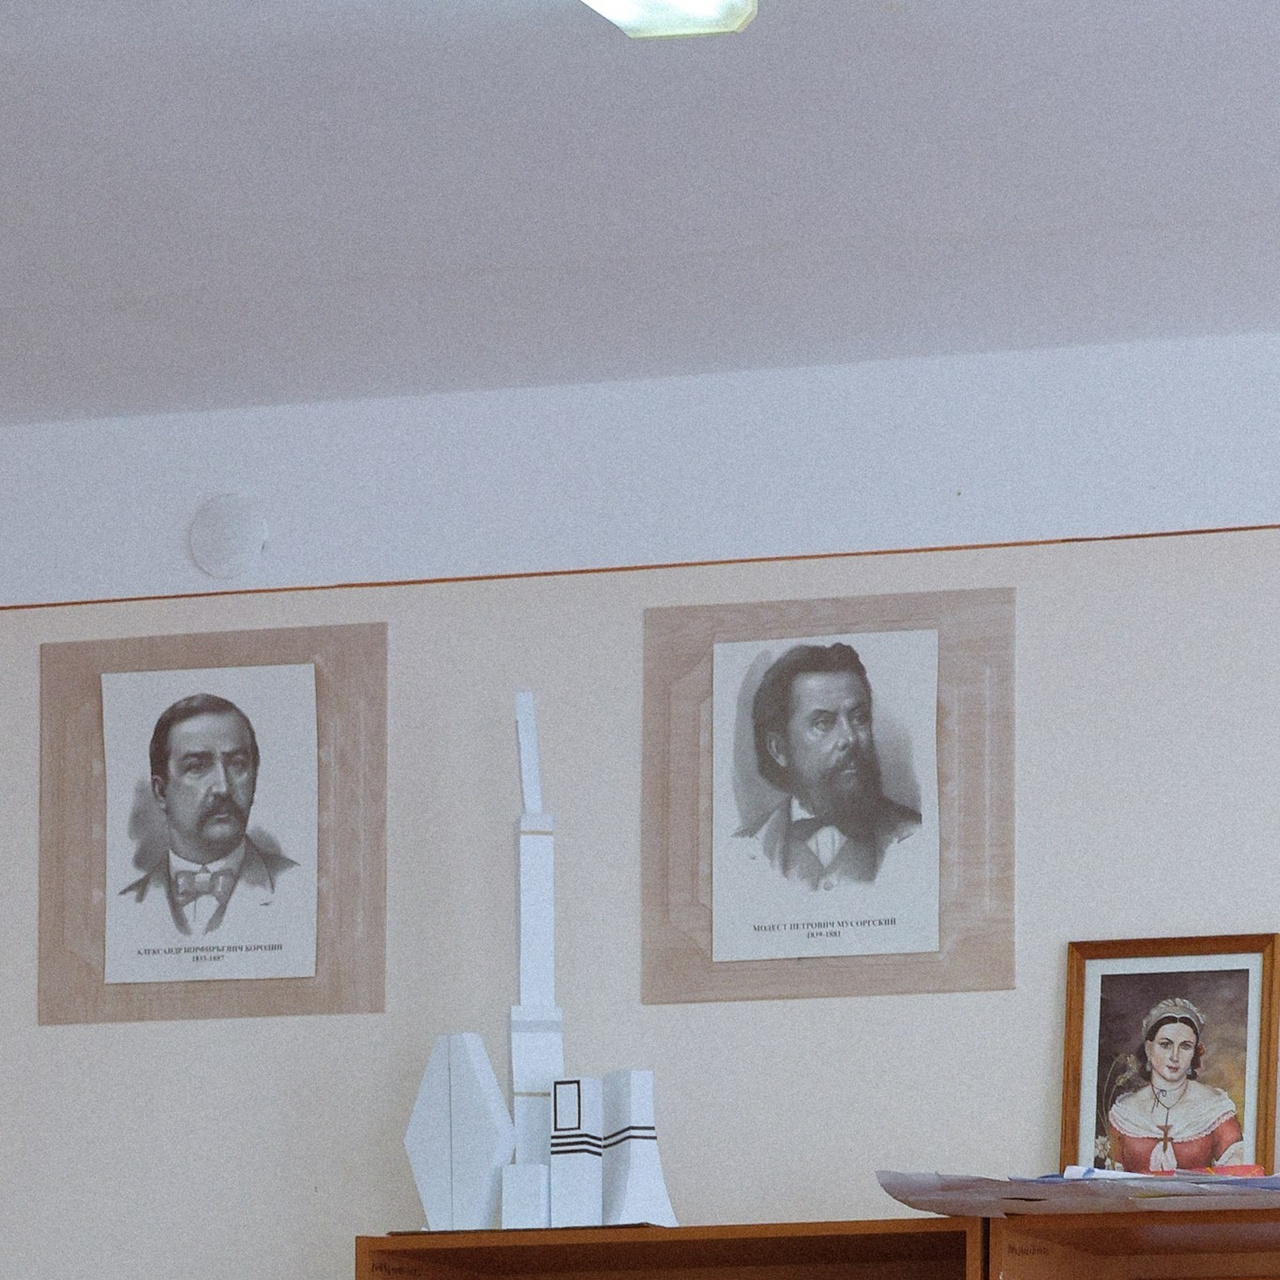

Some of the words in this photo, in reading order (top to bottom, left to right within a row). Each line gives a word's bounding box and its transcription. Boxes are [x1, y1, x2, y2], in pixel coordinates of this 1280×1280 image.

[753, 923, 788, 932] МОДЕСТ
[789, 921, 835, 931] ПЕТРОВИЧ
[837, 916, 896, 928] МУСОРГСКИЙ
[137, 947, 183, 956] АЛЕКСАНДР
